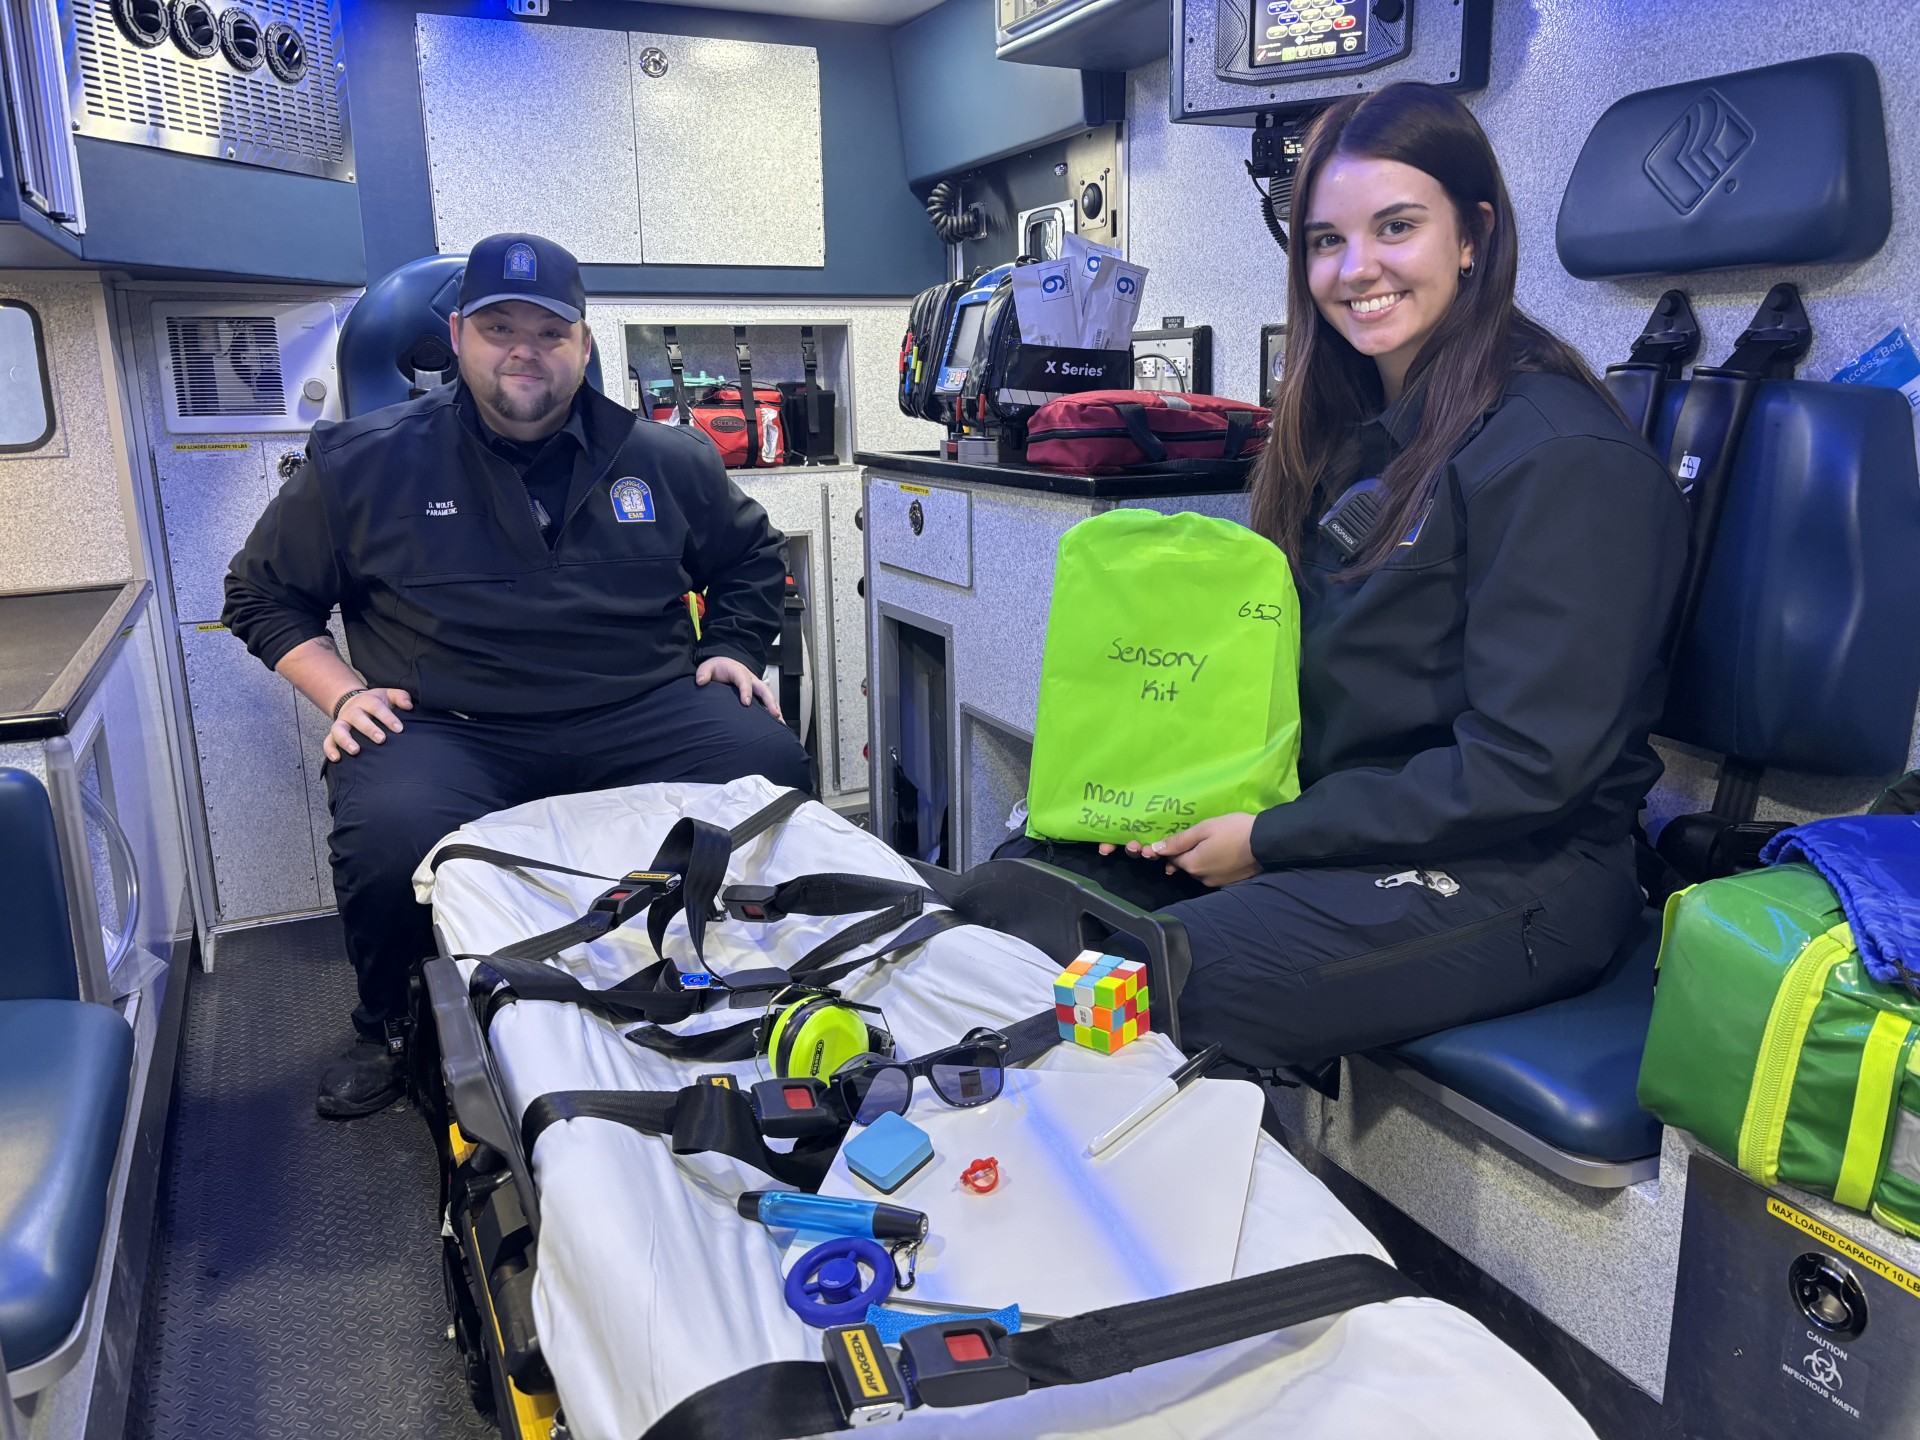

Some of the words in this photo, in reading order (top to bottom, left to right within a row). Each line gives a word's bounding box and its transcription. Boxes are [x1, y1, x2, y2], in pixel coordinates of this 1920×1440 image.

[1042, 274, 1066, 294] 6
[1116, 276, 1136, 295] 6
[1044, 360, 1058, 374] X
[1842, 355, 1880, 385] Access
[1880, 334, 1905, 358] Bag
[428, 501, 435, 509] D.
[435, 500, 455, 509] WOLFE
[1331, 523, 1355, 545] KENWOOD
[1238, 601, 1282, 627] 652
[1108, 638, 1209, 682] Sensory
[1140, 679, 1180, 702] Kit
[1145, 794, 1197, 816] EMS
[1772, 1203, 1793, 1221] MAX
[1794, 1215, 1837, 1244] LOADED
[1838, 1239, 1890, 1274] CAPACITY
[1892, 1270, 1904, 1284] 10
[1806, 1330, 1848, 1361] CAUTION
[1782, 1363, 1829, 1399] INFECTIOUS
[1831, 1394, 1861, 1419] WASTE
